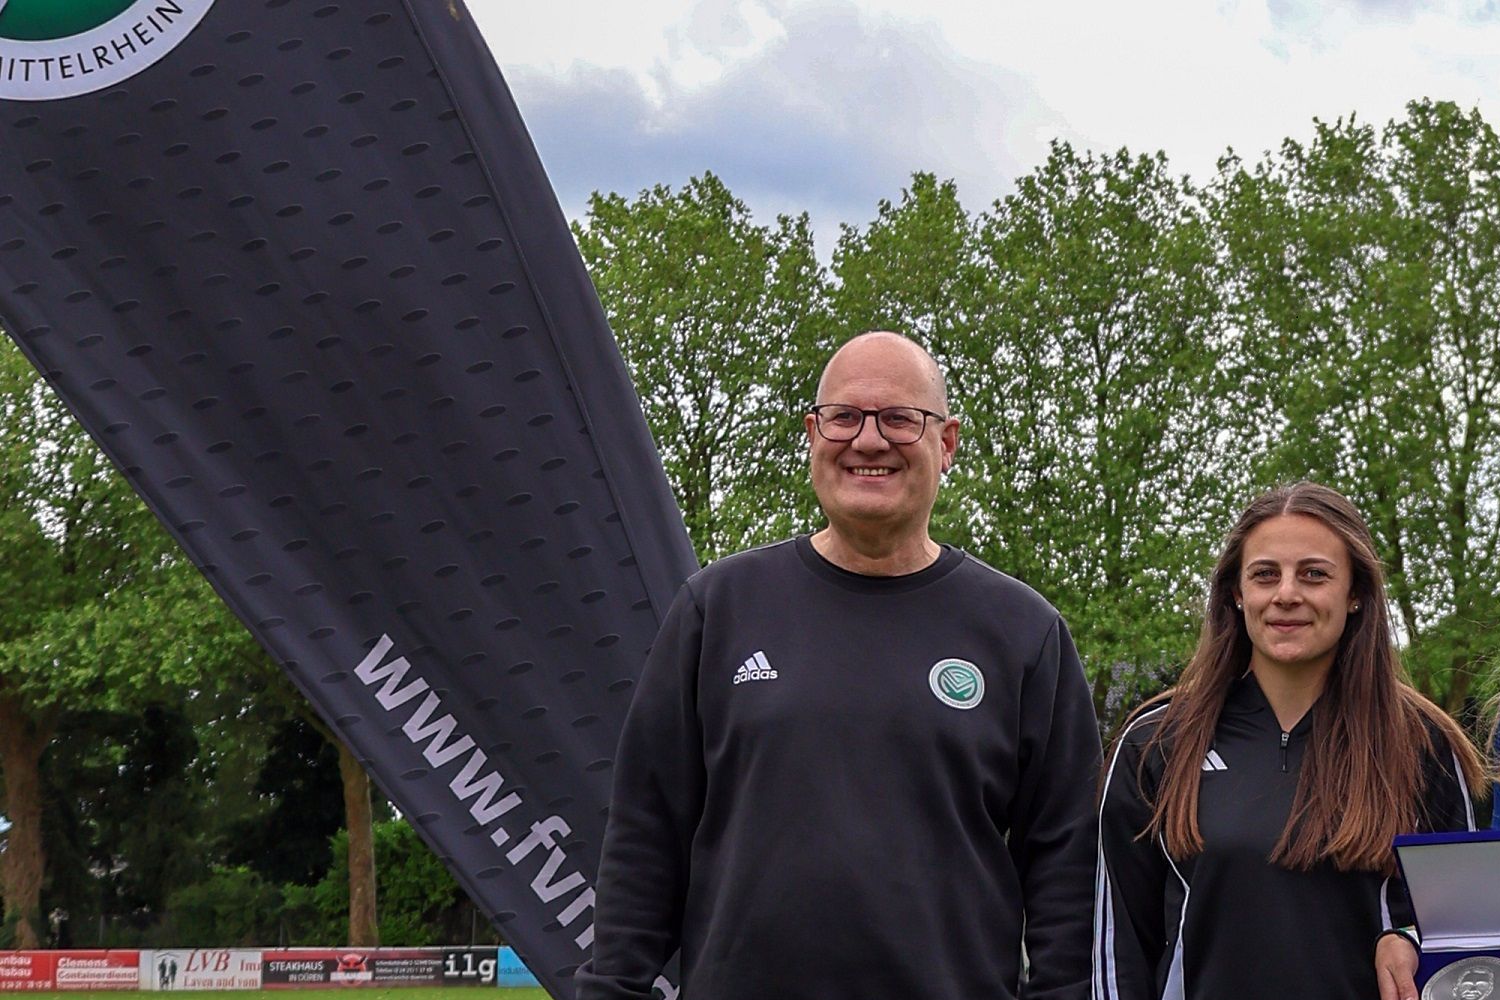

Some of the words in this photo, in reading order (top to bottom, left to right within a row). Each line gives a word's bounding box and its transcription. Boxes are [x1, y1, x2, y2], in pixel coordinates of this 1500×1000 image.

[0, 0, 184, 81] ITTELRHEIN
[733, 669, 778, 685] adidas
[57, 957, 108, 968] Clemens
[184, 949, 231, 972] LVB
[269, 961, 324, 972] STEAKHAUS
[443, 952, 497, 983] ilg
[58, 971, 138, 980] Containerdienst
[288, 973, 297, 982] IN
[298, 972, 324, 982] DÜREN
